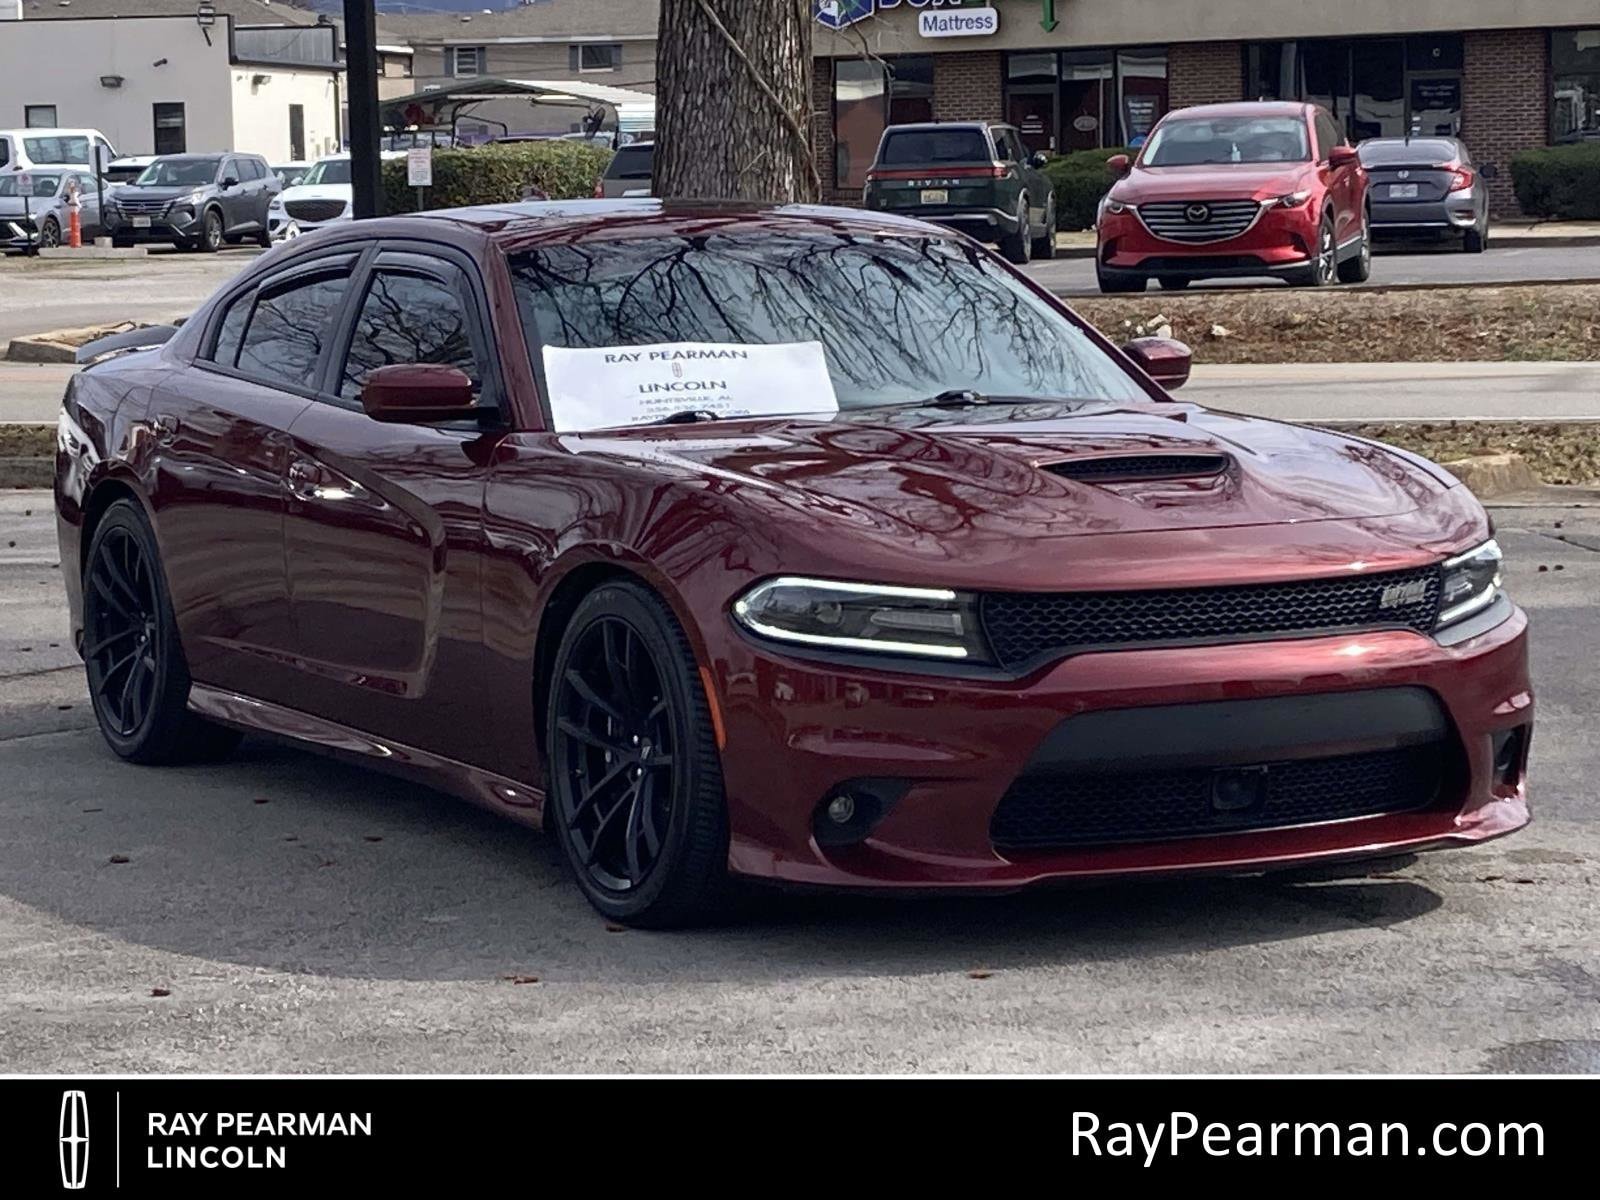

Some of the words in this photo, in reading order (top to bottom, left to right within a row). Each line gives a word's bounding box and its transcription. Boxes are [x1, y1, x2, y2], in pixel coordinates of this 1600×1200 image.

[923, 16, 993, 32] Mattress
[605, 352, 640, 363] RAY
[649, 350, 748, 361] PEARMAN
[639, 381, 727, 393] LINCOLN
